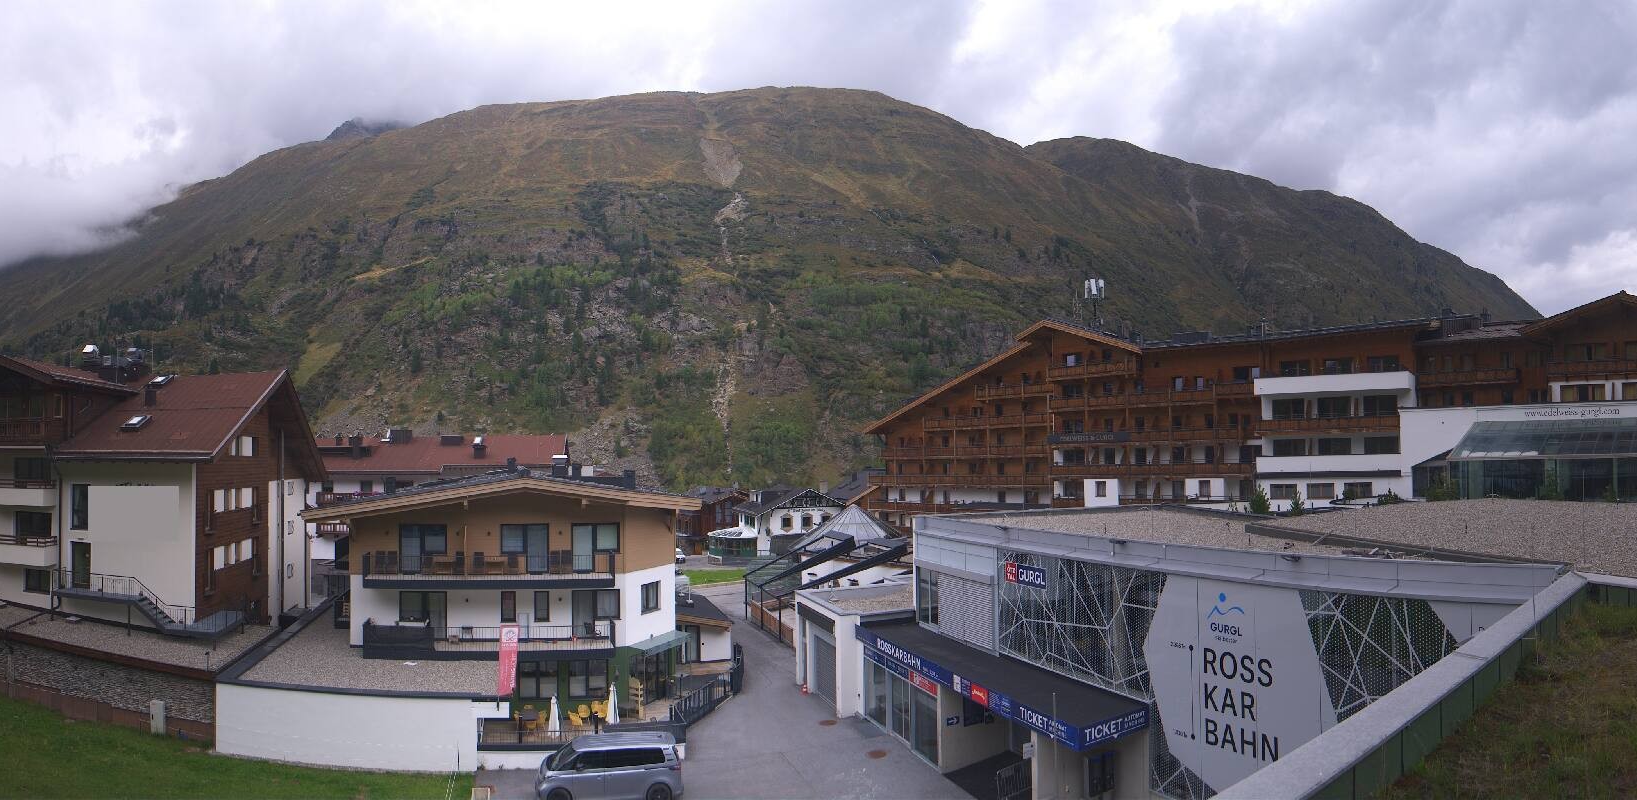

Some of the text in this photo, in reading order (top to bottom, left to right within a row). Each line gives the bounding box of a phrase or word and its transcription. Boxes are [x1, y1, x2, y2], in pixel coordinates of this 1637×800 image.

[1524, 407, 1620, 418] www.edelweiss-gurgl.com
[1018, 568, 1045, 585] GURGL
[1210, 622, 1243, 637] GURGL
[876, 637, 921, 670] ROSSKARBAHN
[1203, 647, 1273, 687] ROSS
[1204, 683, 1256, 722] KAR
[1019, 706, 1048, 730] TICKET
[1084, 718, 1123, 742] TICKET
[1205, 718, 1279, 762] BAHN
